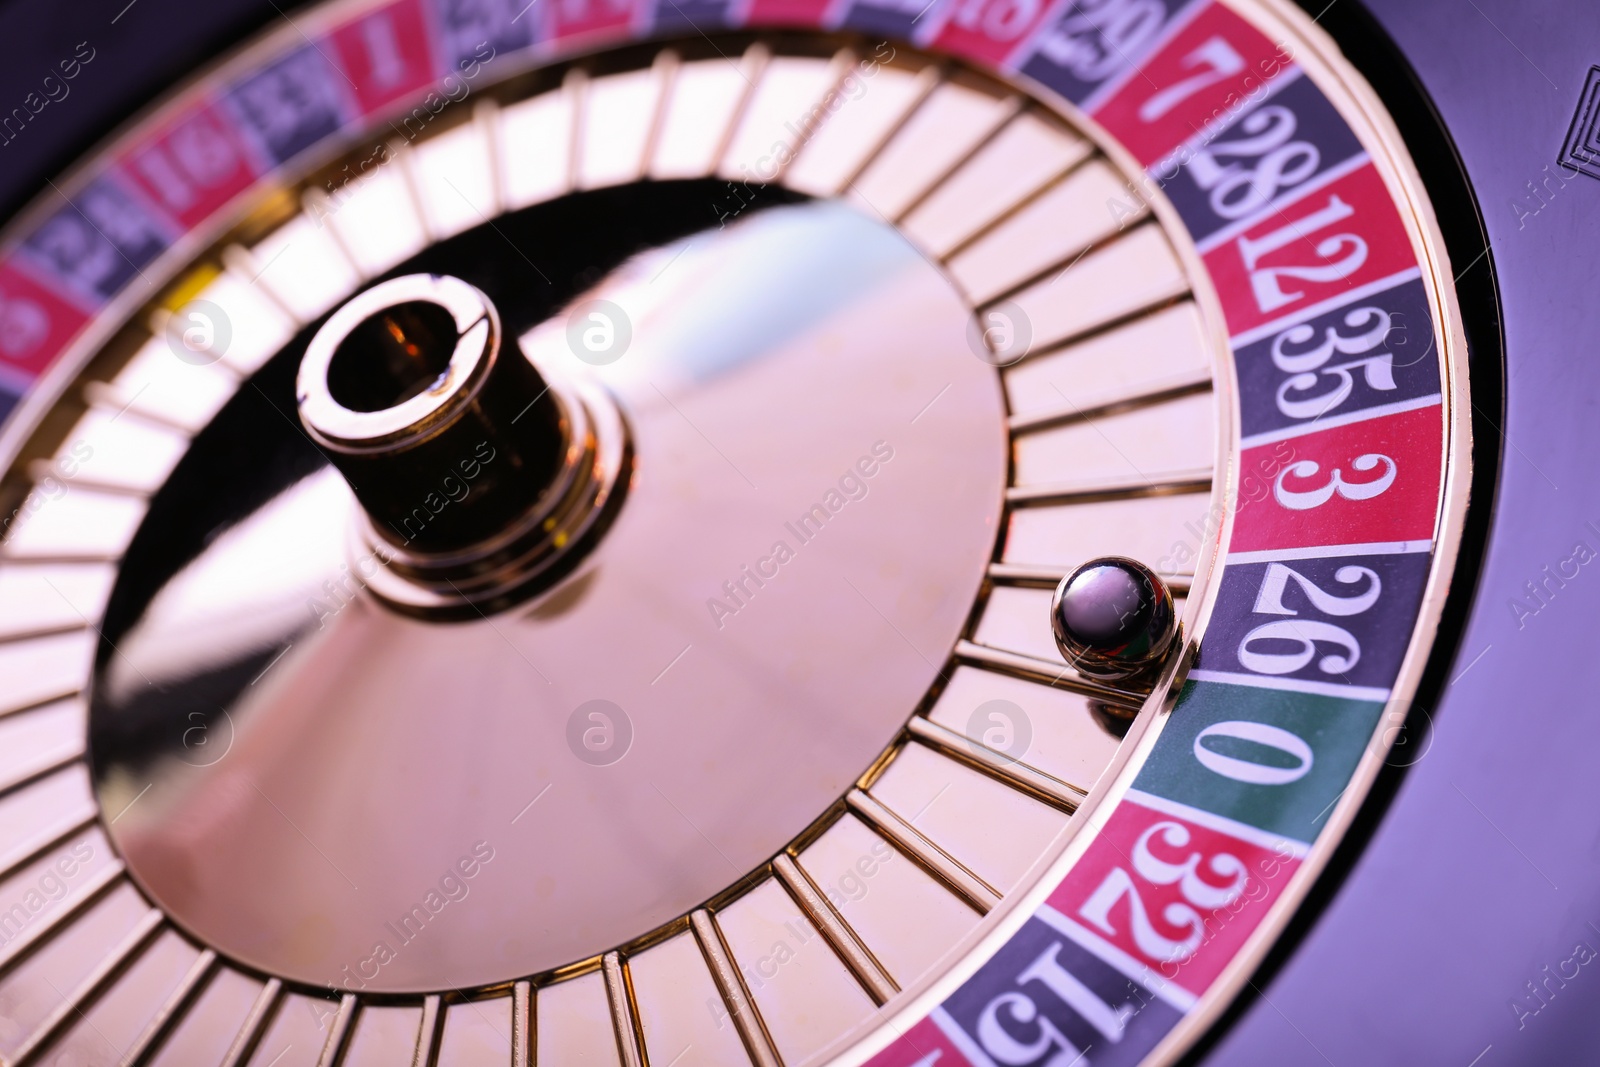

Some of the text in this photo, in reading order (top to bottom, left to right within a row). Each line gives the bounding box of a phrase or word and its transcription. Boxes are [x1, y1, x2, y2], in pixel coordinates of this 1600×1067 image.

[360, 10, 404, 86] 1
[1136, 34, 1247, 123] 7
[136, 112, 243, 210] 16
[1184, 104, 1321, 220] 28
[1236, 193, 1370, 314] 12
[1270, 305, 1399, 419] 35
[1272, 453, 1398, 511] 3
[1237, 562, 1382, 675] 26
[1193, 720, 1314, 786] 0
[1078, 821, 1249, 963] 32
[976, 940, 1134, 1067] 15
